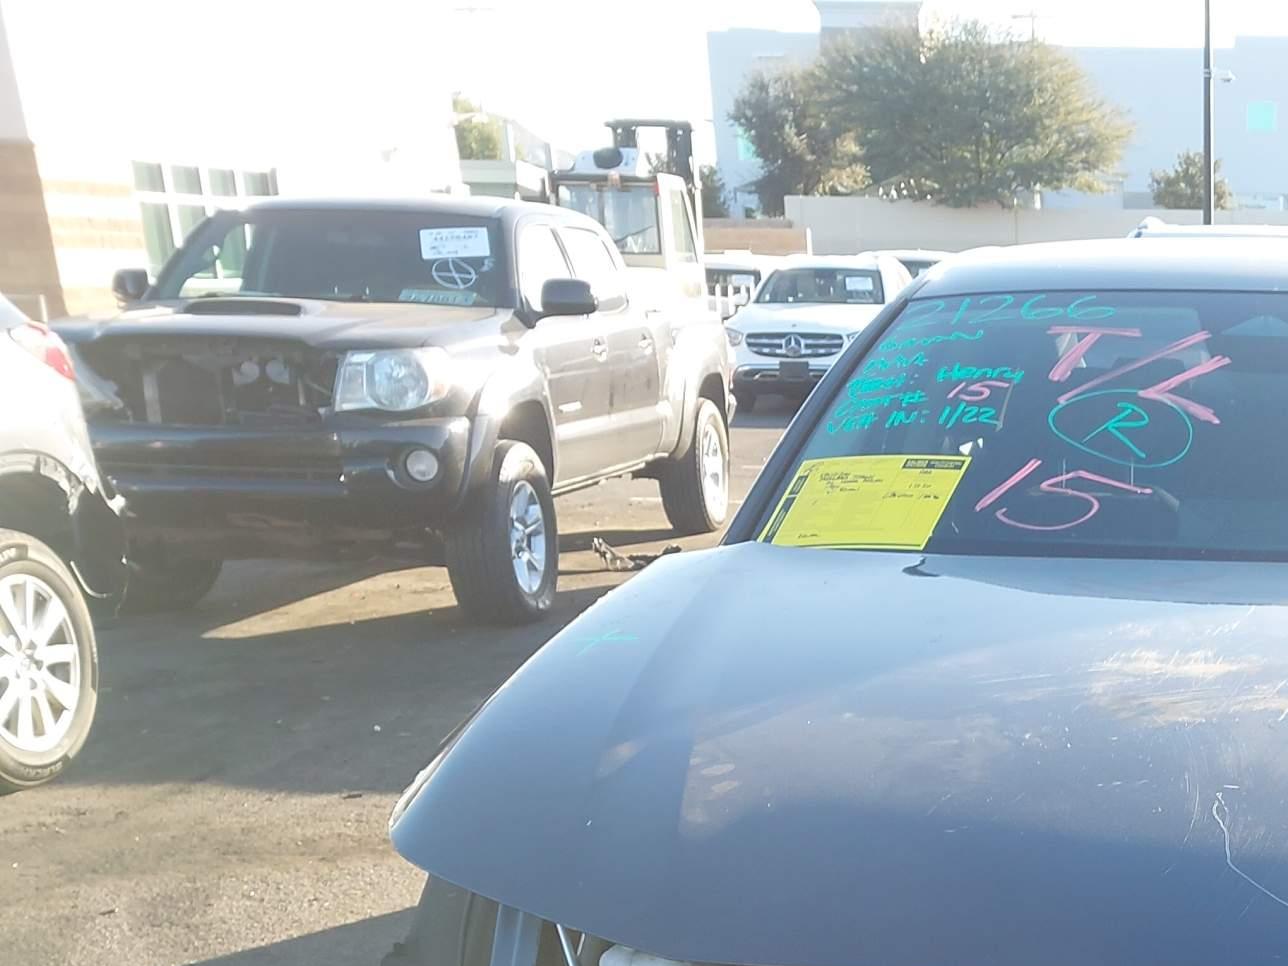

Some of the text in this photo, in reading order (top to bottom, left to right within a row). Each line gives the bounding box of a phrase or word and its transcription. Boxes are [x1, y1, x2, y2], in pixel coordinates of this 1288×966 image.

[898, 294, 1116, 332] 21266
[946, 380, 1010, 401] 15
[938, 402, 1001, 429] 1/22
[1081, 401, 1150, 458] R
[975, 458, 1152, 530] 15
